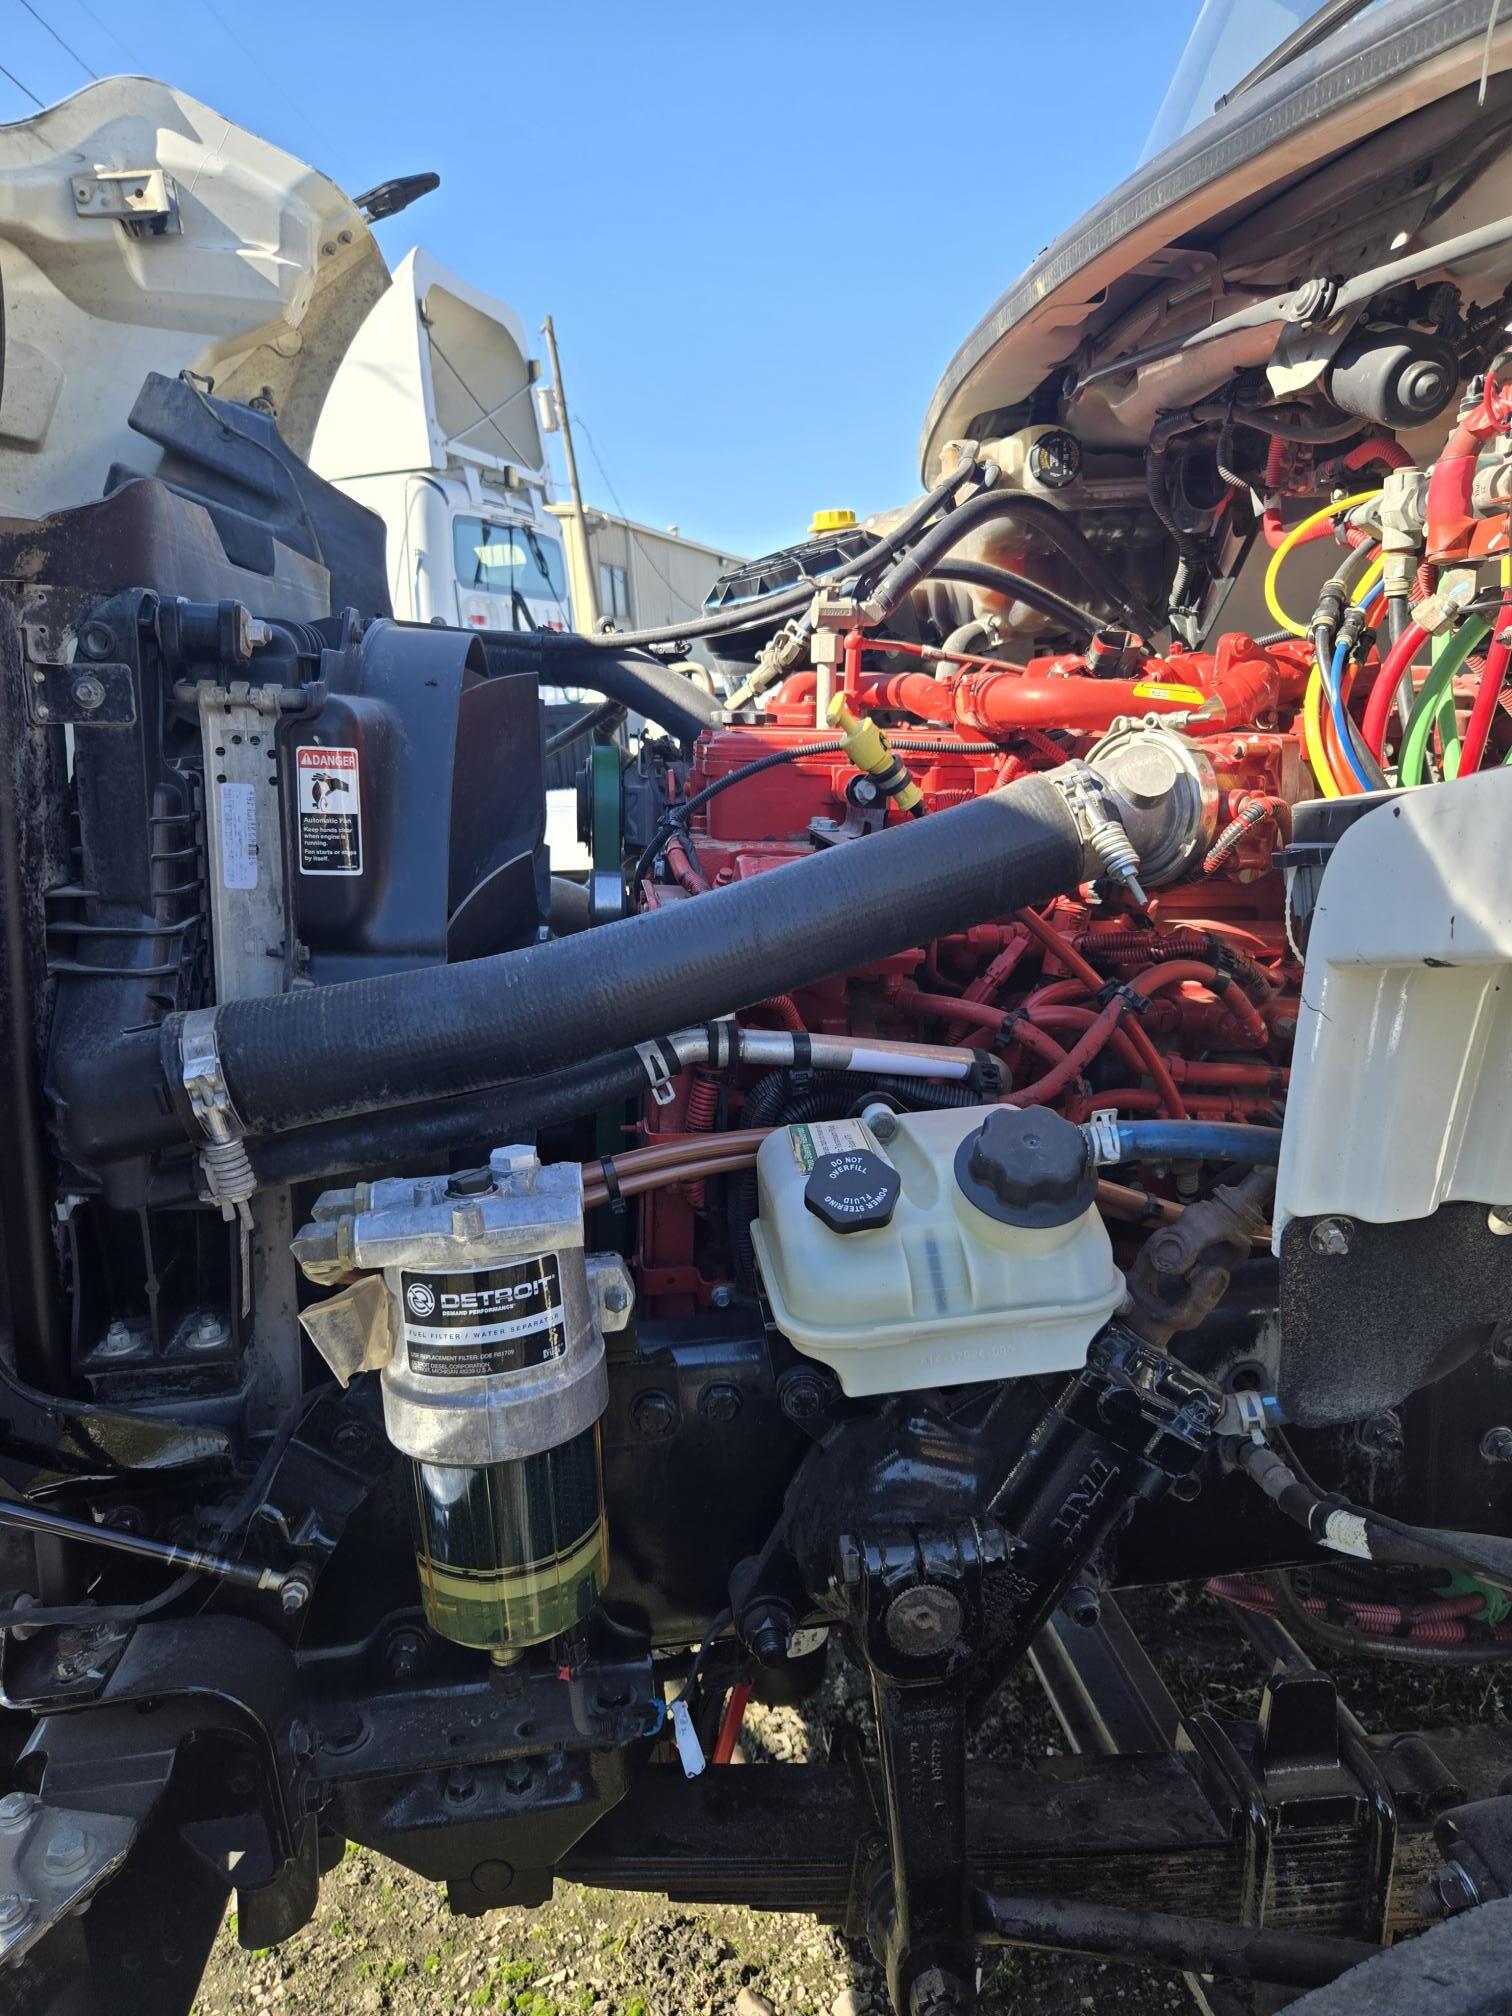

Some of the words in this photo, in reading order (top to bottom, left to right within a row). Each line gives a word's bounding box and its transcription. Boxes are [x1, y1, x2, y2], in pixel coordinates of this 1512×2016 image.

[312, 754, 356, 766] DANGER
[830, 1158, 843, 1167] DO
[829, 1164, 867, 1179] OVERFILL
[824, 1195, 865, 1213] STEERING
[843, 1193, 872, 1205] FLUID
[865, 1187, 888, 1210] POWER
[440, 1275, 552, 1309] DETROIT
[468, 1304, 514, 1316] PERFORMANCE
[408, 1328, 427, 1338] FUEL
[472, 1329, 505, 1339] WATER
[420, 1353, 457, 1361] REPLACEMENT
